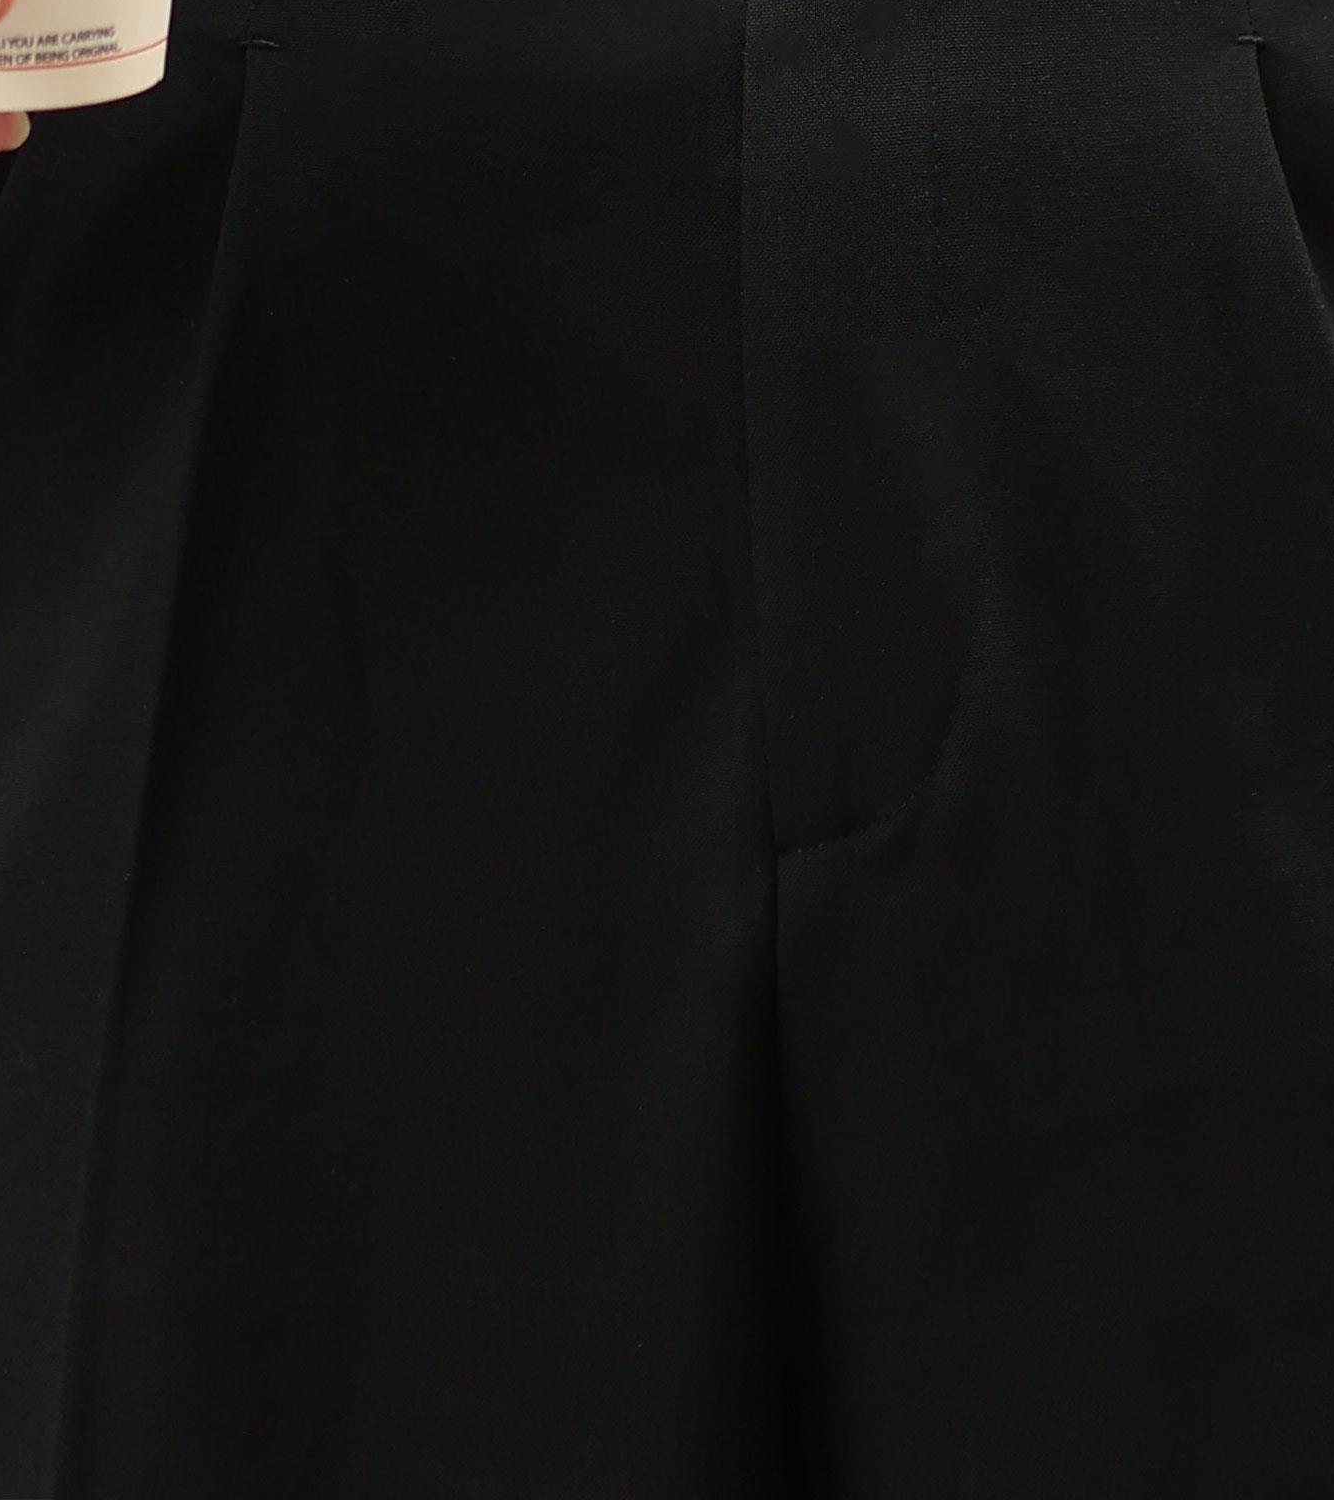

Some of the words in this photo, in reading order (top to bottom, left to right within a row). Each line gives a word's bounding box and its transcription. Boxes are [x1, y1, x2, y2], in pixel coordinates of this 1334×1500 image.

[7, 36, 34, 49] YOU
[36, 33, 59, 47] ARE
[61, 25, 115, 44] CARRYING
[15, 52, 32, 65] OF
[34, 49, 70, 63] BEING
